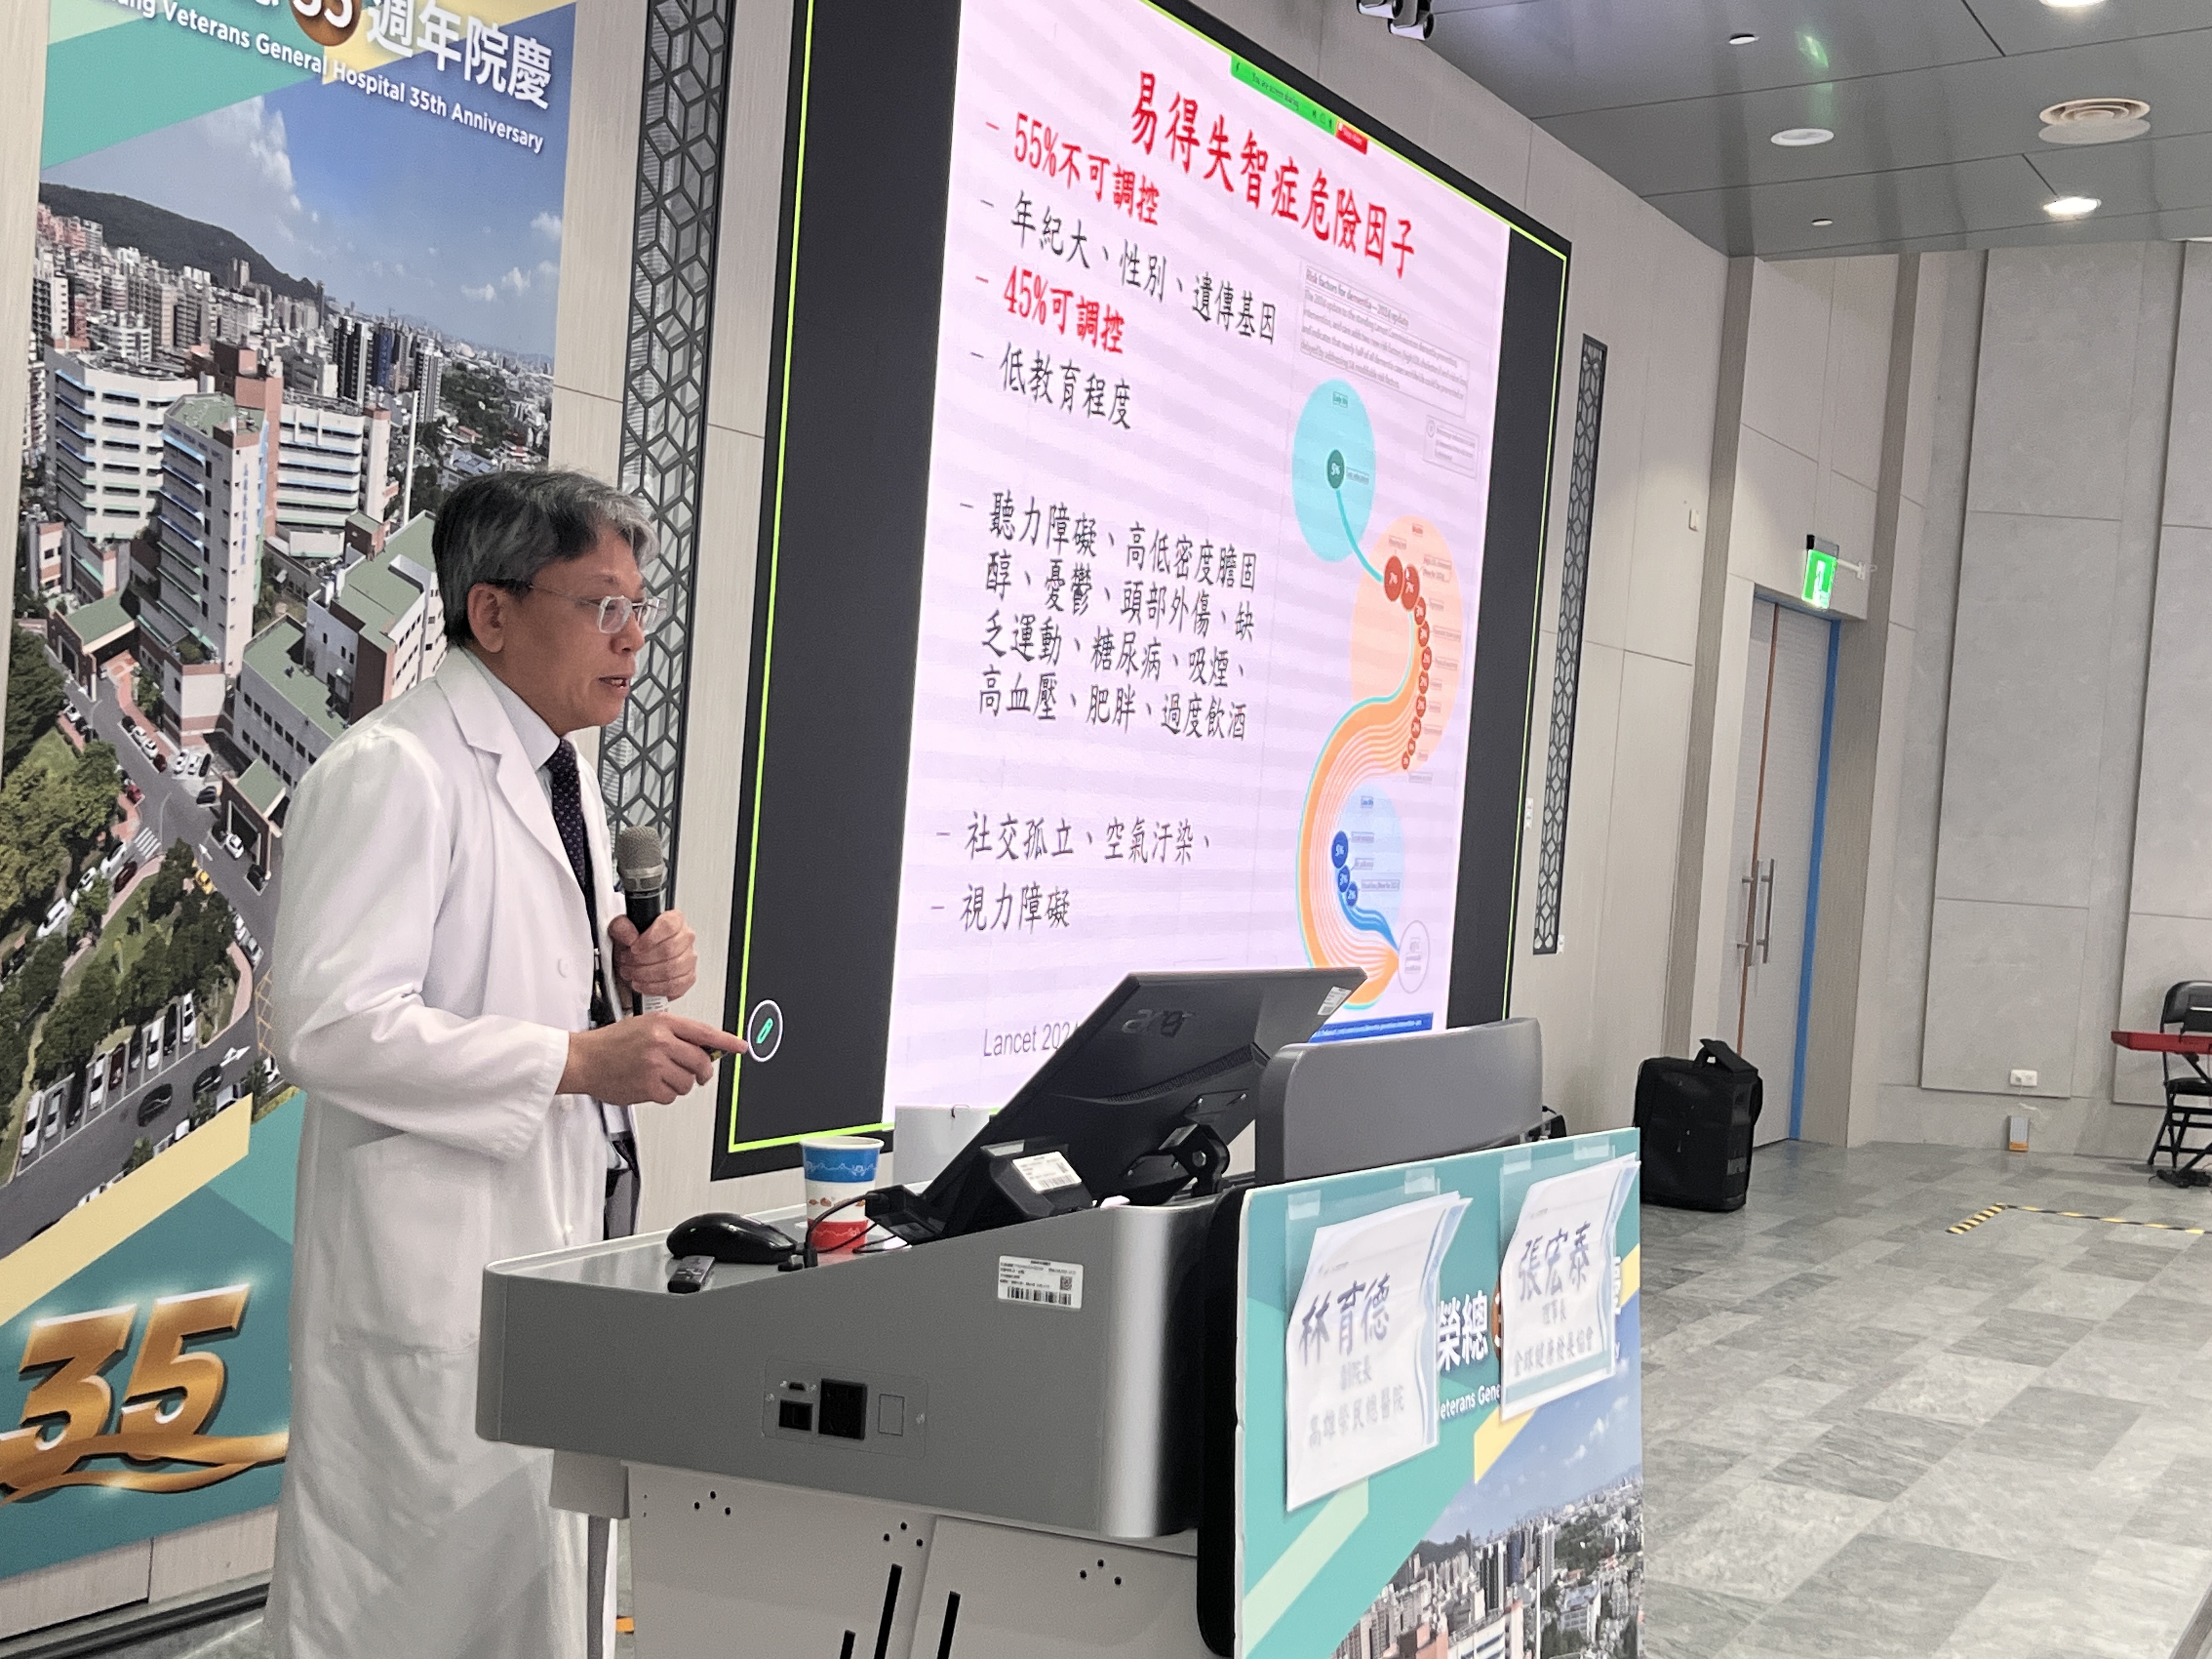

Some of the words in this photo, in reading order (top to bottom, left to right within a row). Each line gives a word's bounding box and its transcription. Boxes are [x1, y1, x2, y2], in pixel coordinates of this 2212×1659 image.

[163, 0, 250, 48] Veterans
[256, 33, 327, 75] General
[333, 60, 405, 102] Hospital
[409, 86, 447, 117] 35th
[450, 103, 543, 154] Anniversary
[1014, 112, 1160, 225] 55%不可調控
[1131, 70, 1414, 279] 易得失智症危險因子
[1003, 266, 1124, 354] 45%可調控
[1011, 190, 1276, 345] 年紀大、性別、遺傳基因
[1000, 342, 1131, 431] 低教育程度
[989, 489, 1257, 594] 聽力障礙、高低密度膽固
[986, 549, 1254, 642] 醇、憂鬱、頭部外傷、缺
[979, 664, 1247, 741] 高血壓、肥胖、過度飲酒
[960, 881, 1070, 934] 視力障礙
[984, 1025, 1036, 1057] Lancet
[1042, 1020, 1079, 1051] 202
[1299, 1272, 1390, 1367] 林育德
[0, 1282, 251, 1491] 35
[1440, 1392, 1476, 1420] eterans
